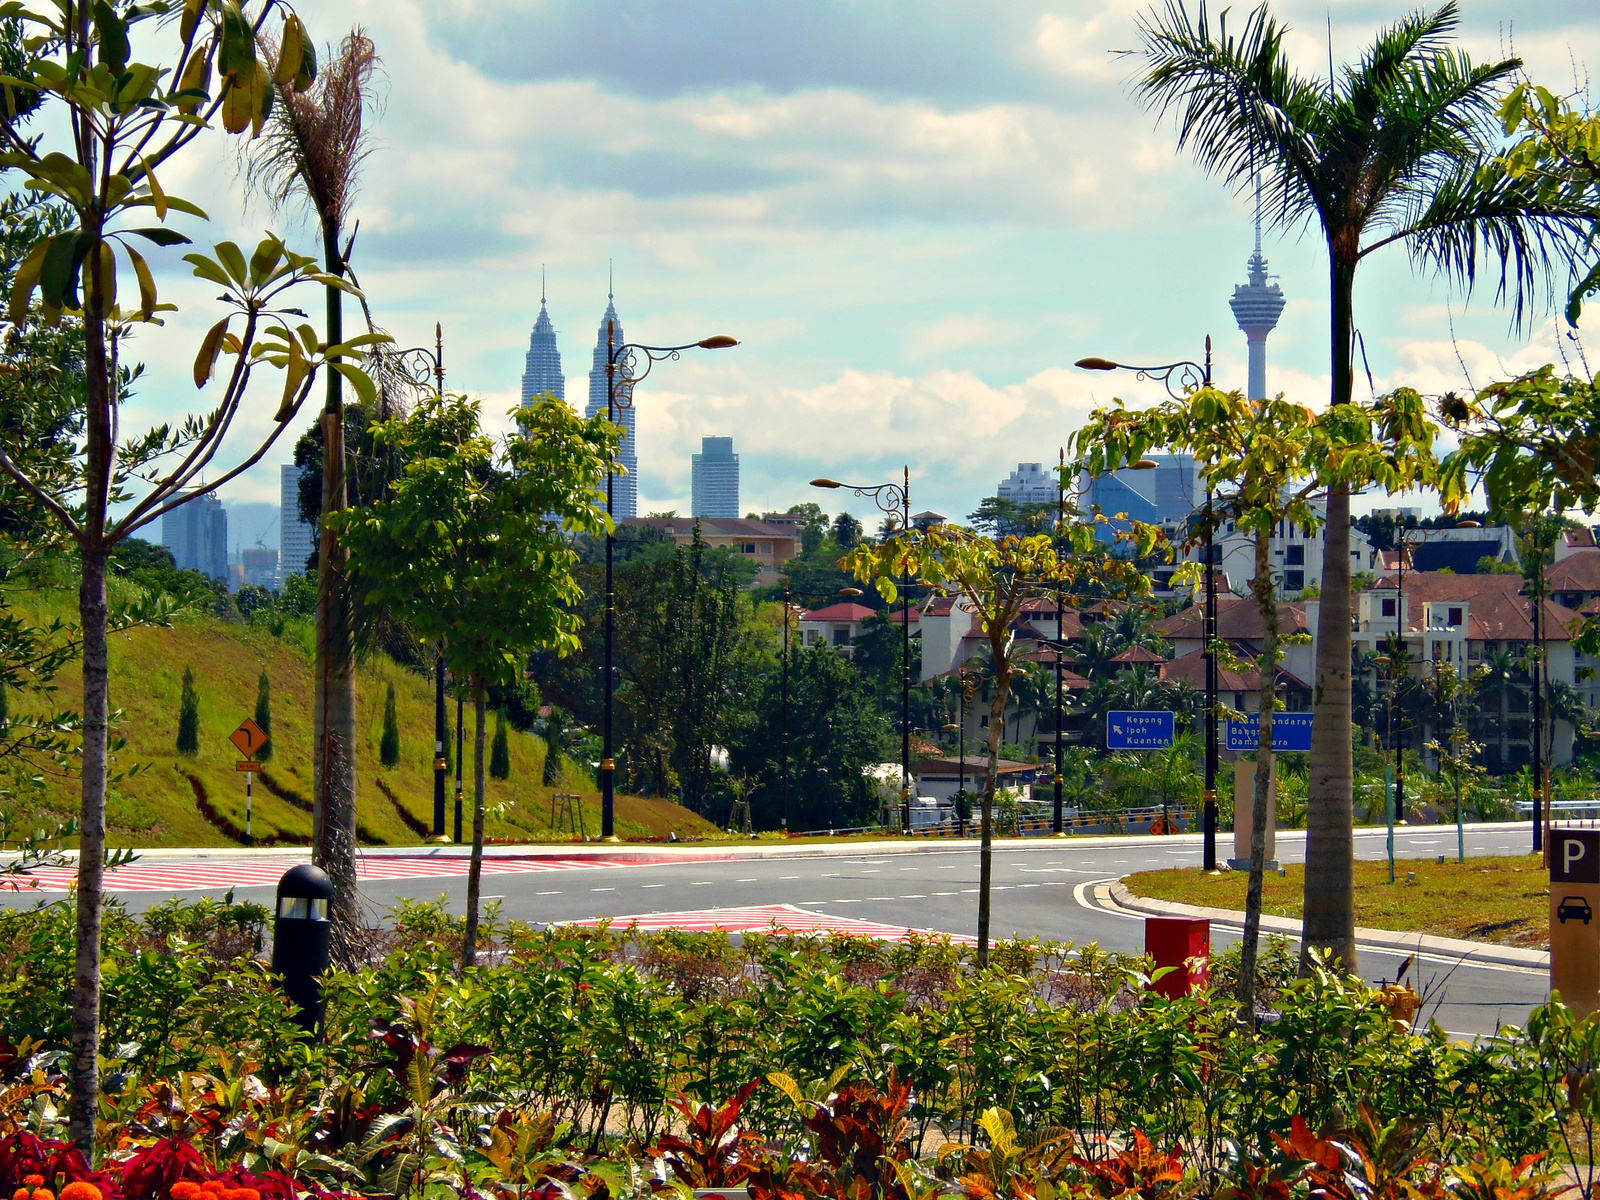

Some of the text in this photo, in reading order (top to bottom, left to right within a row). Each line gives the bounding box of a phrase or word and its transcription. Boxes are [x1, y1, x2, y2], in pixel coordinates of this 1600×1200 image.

[1126, 716, 1162, 726] Kepong
[1126, 727, 1147, 735] Ipoh
[1126, 737, 1169, 745] Kuantan
[1231, 738, 1288, 746] Damaara
[1563, 839, 1586, 874] P
